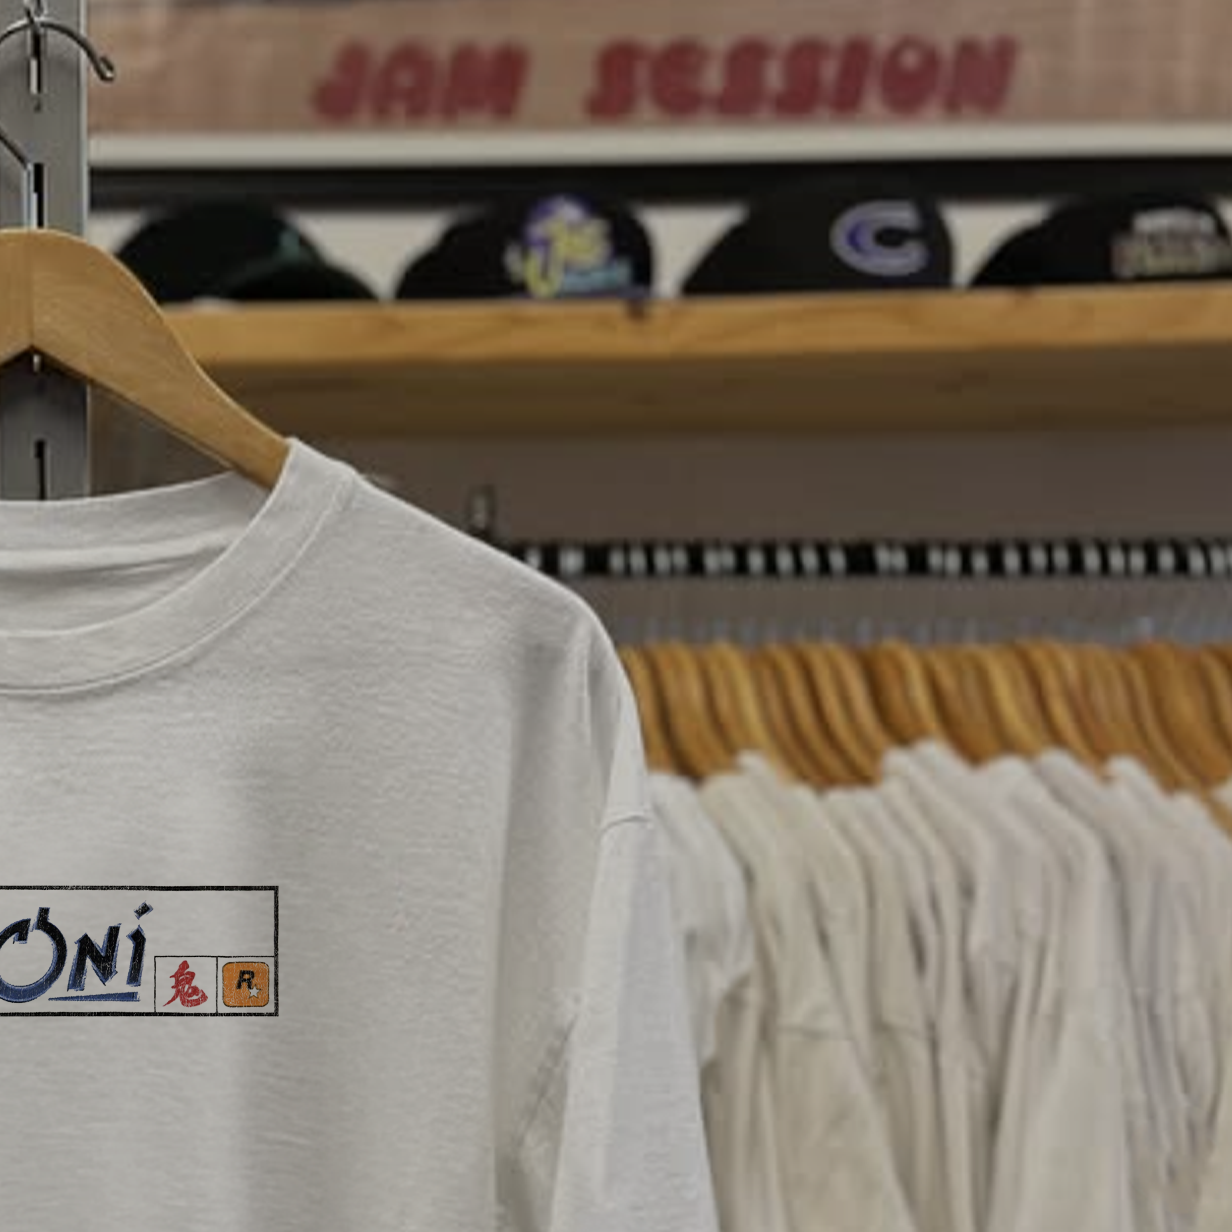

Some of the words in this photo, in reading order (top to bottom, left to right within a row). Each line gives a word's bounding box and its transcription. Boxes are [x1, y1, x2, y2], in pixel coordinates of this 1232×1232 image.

[314, 40, 530, 122] JAM
[584, 36, 1019, 121] SESSION
[829, 199, 927, 276] C
[235, 969, 255, 990] R
